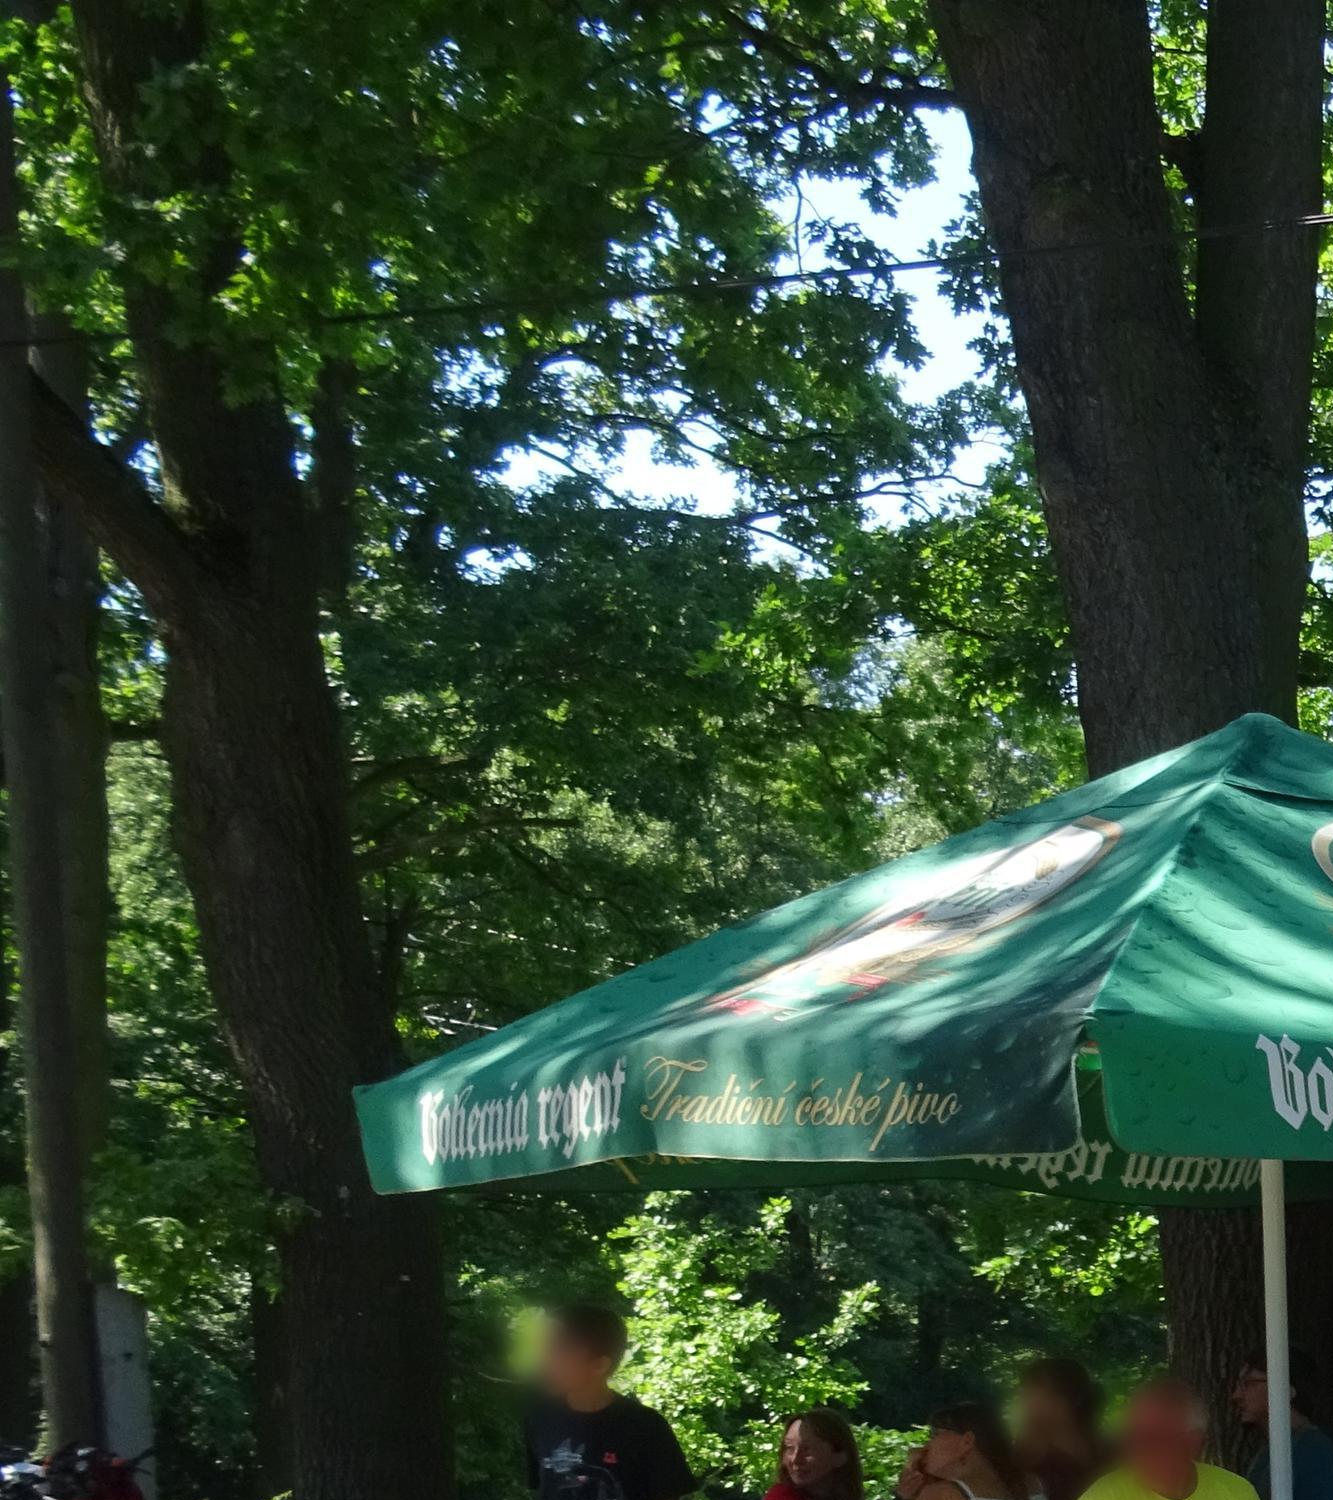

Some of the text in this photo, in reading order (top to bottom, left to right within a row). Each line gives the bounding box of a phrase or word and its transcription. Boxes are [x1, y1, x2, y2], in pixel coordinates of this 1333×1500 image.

[420, 1055, 963, 1166] Bohemia regent Tradiční české pivo
